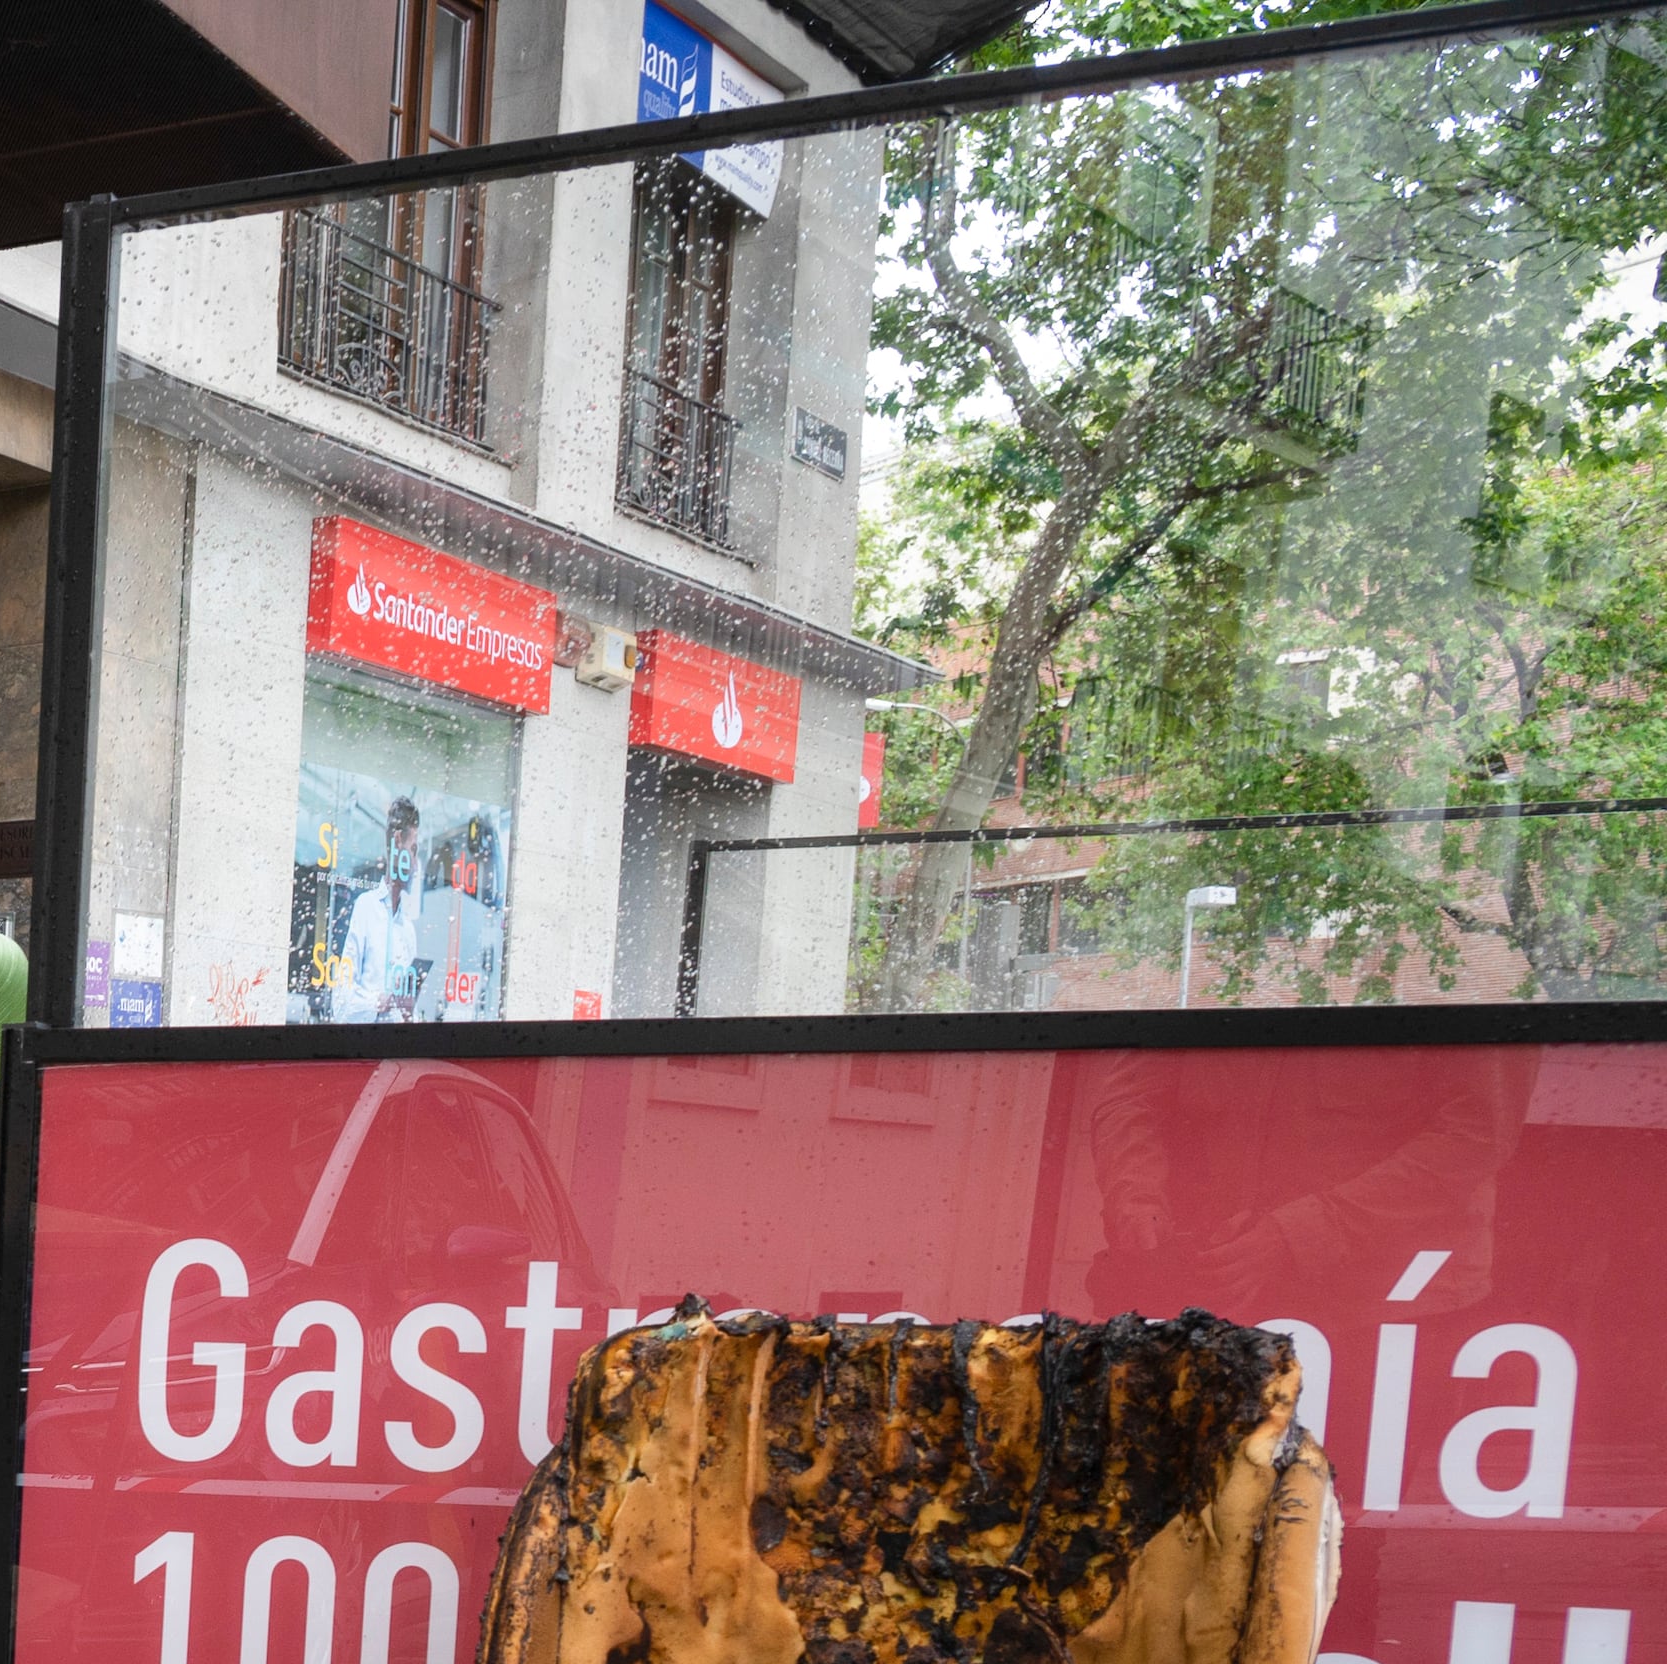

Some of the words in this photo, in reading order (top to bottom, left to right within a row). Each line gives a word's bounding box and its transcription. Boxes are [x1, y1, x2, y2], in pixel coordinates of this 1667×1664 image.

[373, 582, 466, 646] Santander
[466, 614, 543, 670] Empresas
[318, 823, 338, 869] Si
[389, 838, 411, 882] te
[452, 852, 477, 893] da
[121, 998, 144, 1012] mam
[311, 943, 353, 989] San
[445, 961, 478, 1003] der
[136, 1238, 1581, 1520] Gastía
